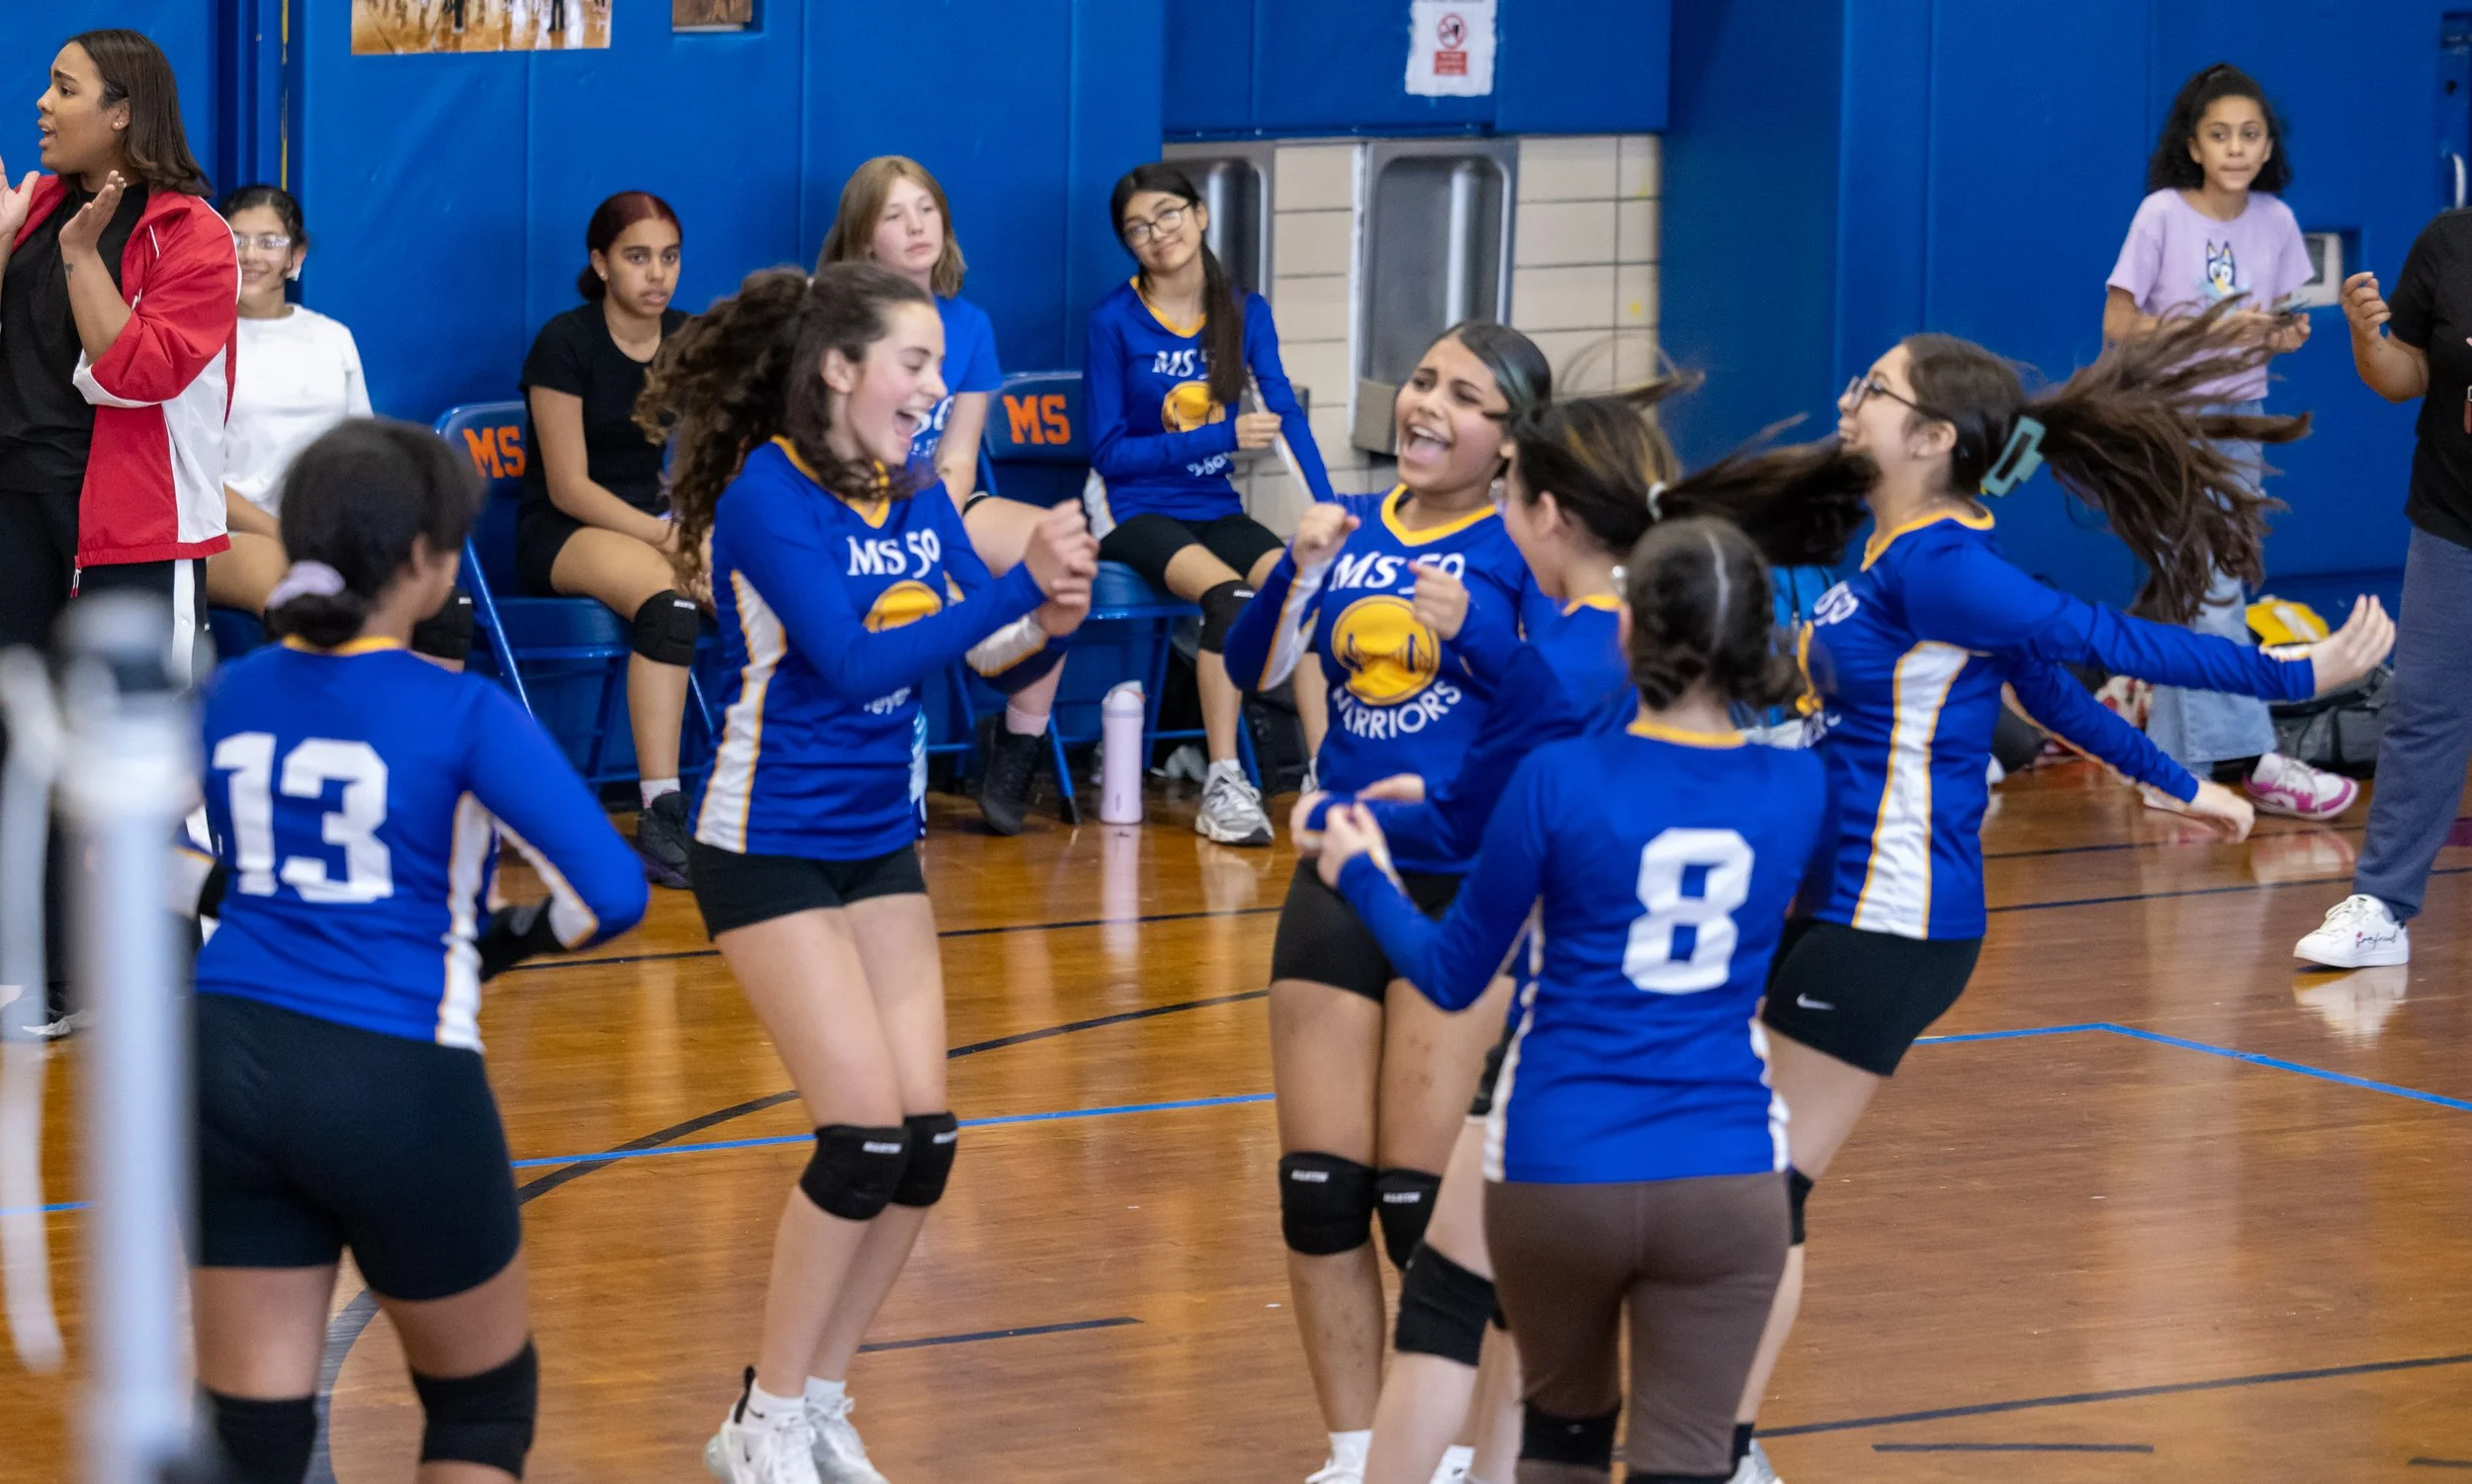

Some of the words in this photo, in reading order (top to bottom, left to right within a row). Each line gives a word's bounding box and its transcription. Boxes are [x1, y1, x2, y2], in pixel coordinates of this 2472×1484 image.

[1151, 348, 1197, 378] MS
[1003, 394, 1071, 445] MS
[463, 426, 526, 479] MS
[846, 535, 907, 576] MS
[907, 528, 940, 578] 50
[1328, 551, 1408, 592] MS
[212, 731, 395, 904] 13
[1622, 827, 1755, 996] 8
